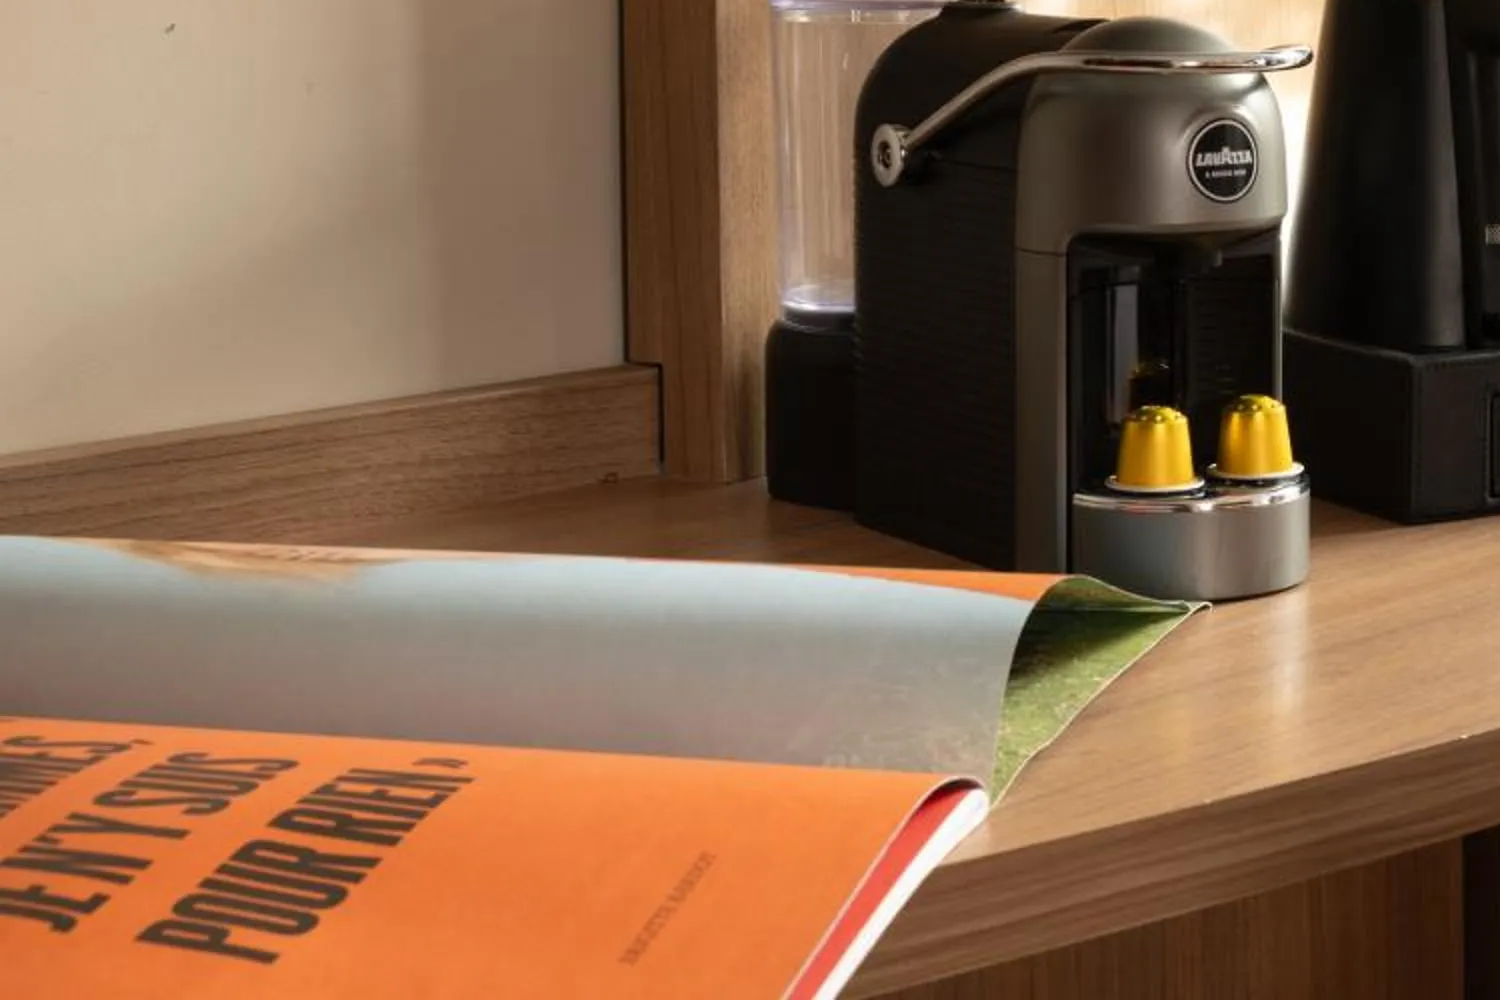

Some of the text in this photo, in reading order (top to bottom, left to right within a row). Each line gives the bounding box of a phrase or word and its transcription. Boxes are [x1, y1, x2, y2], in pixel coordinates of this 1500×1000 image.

[1195, 146, 1253, 167] LAVAZZA
[0, 884, 111, 933] JE
[92, 752, 300, 816] SUIS
[134, 838, 384, 965] POUR
[266, 768, 477, 847] RIEN
